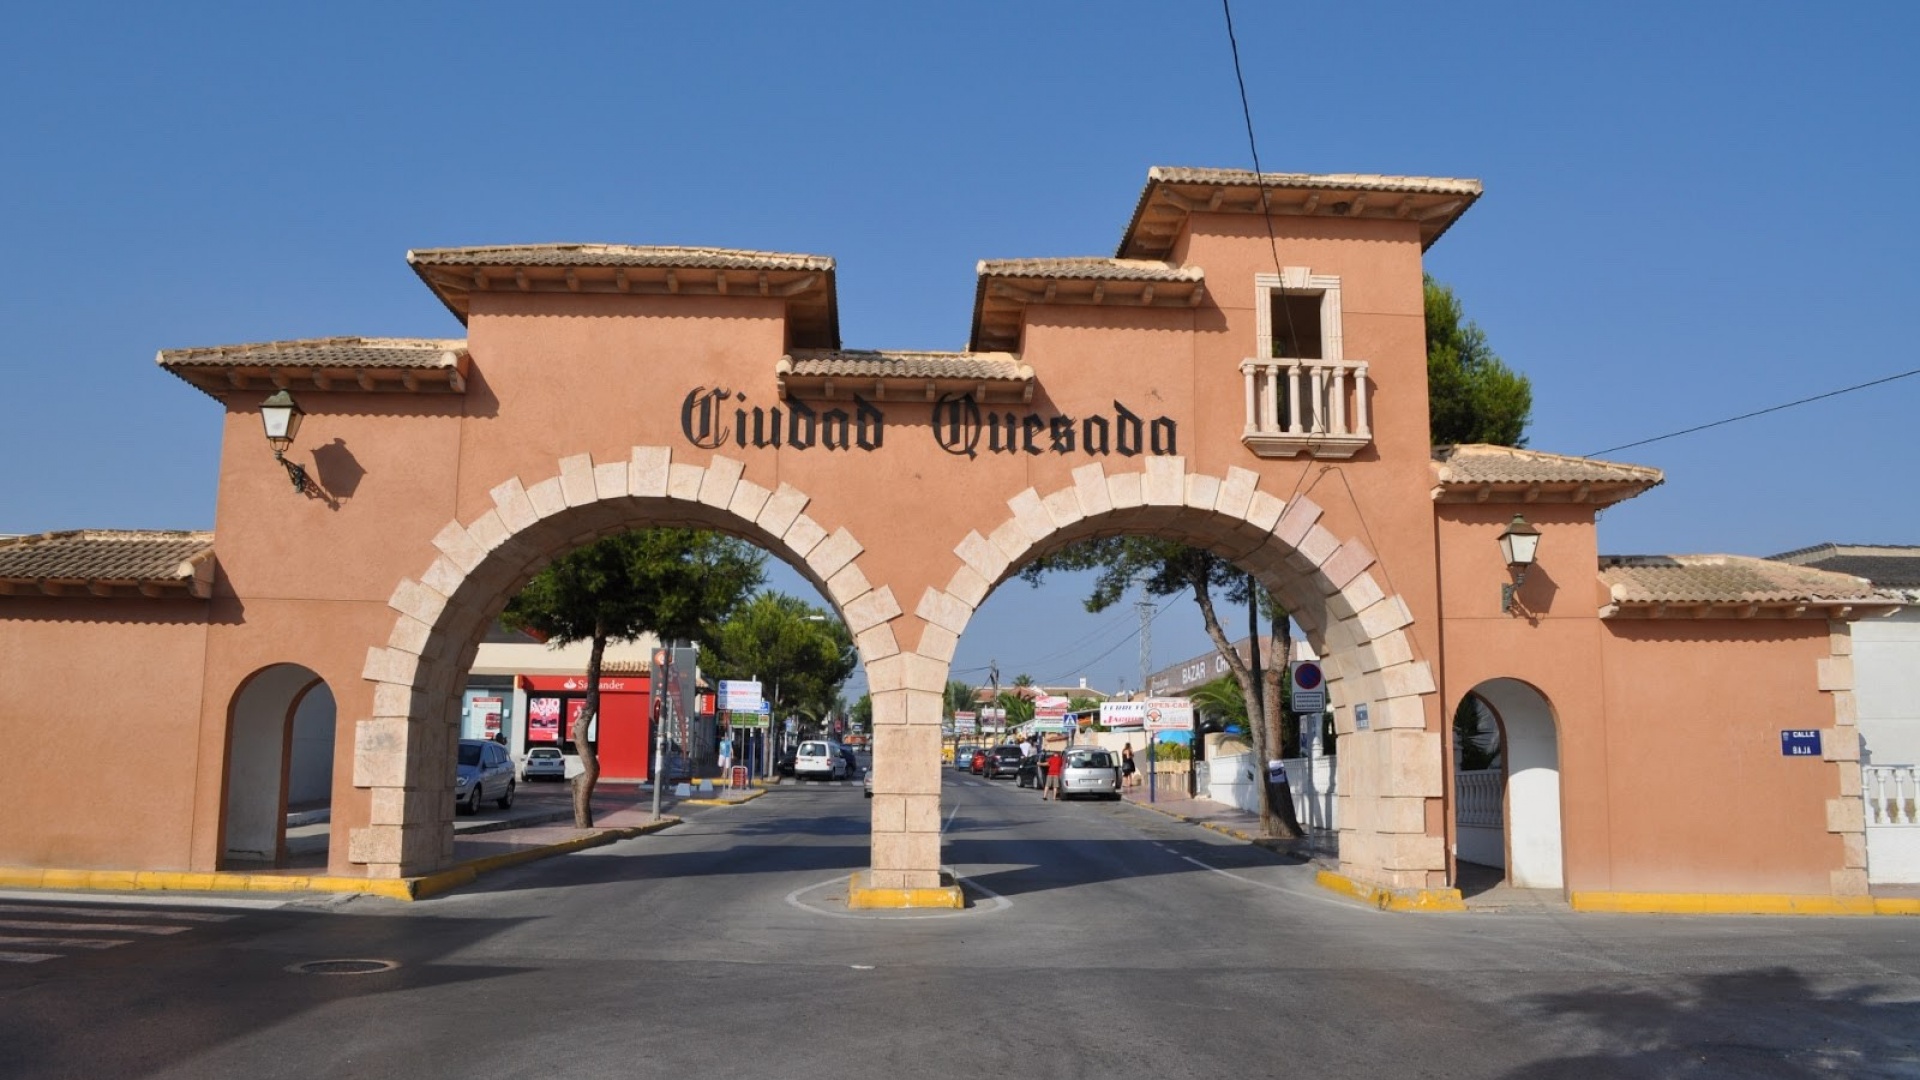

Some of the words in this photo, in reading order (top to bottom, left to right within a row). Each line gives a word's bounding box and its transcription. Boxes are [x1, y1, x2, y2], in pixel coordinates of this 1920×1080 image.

[681, 385, 884, 451] Ciudad
[931, 391, 1178, 461] Quesada
[1182, 661, 1206, 685] BAZAR
[577, 678, 625, 690] Saander
[1792, 746, 1812, 755] BAJA
